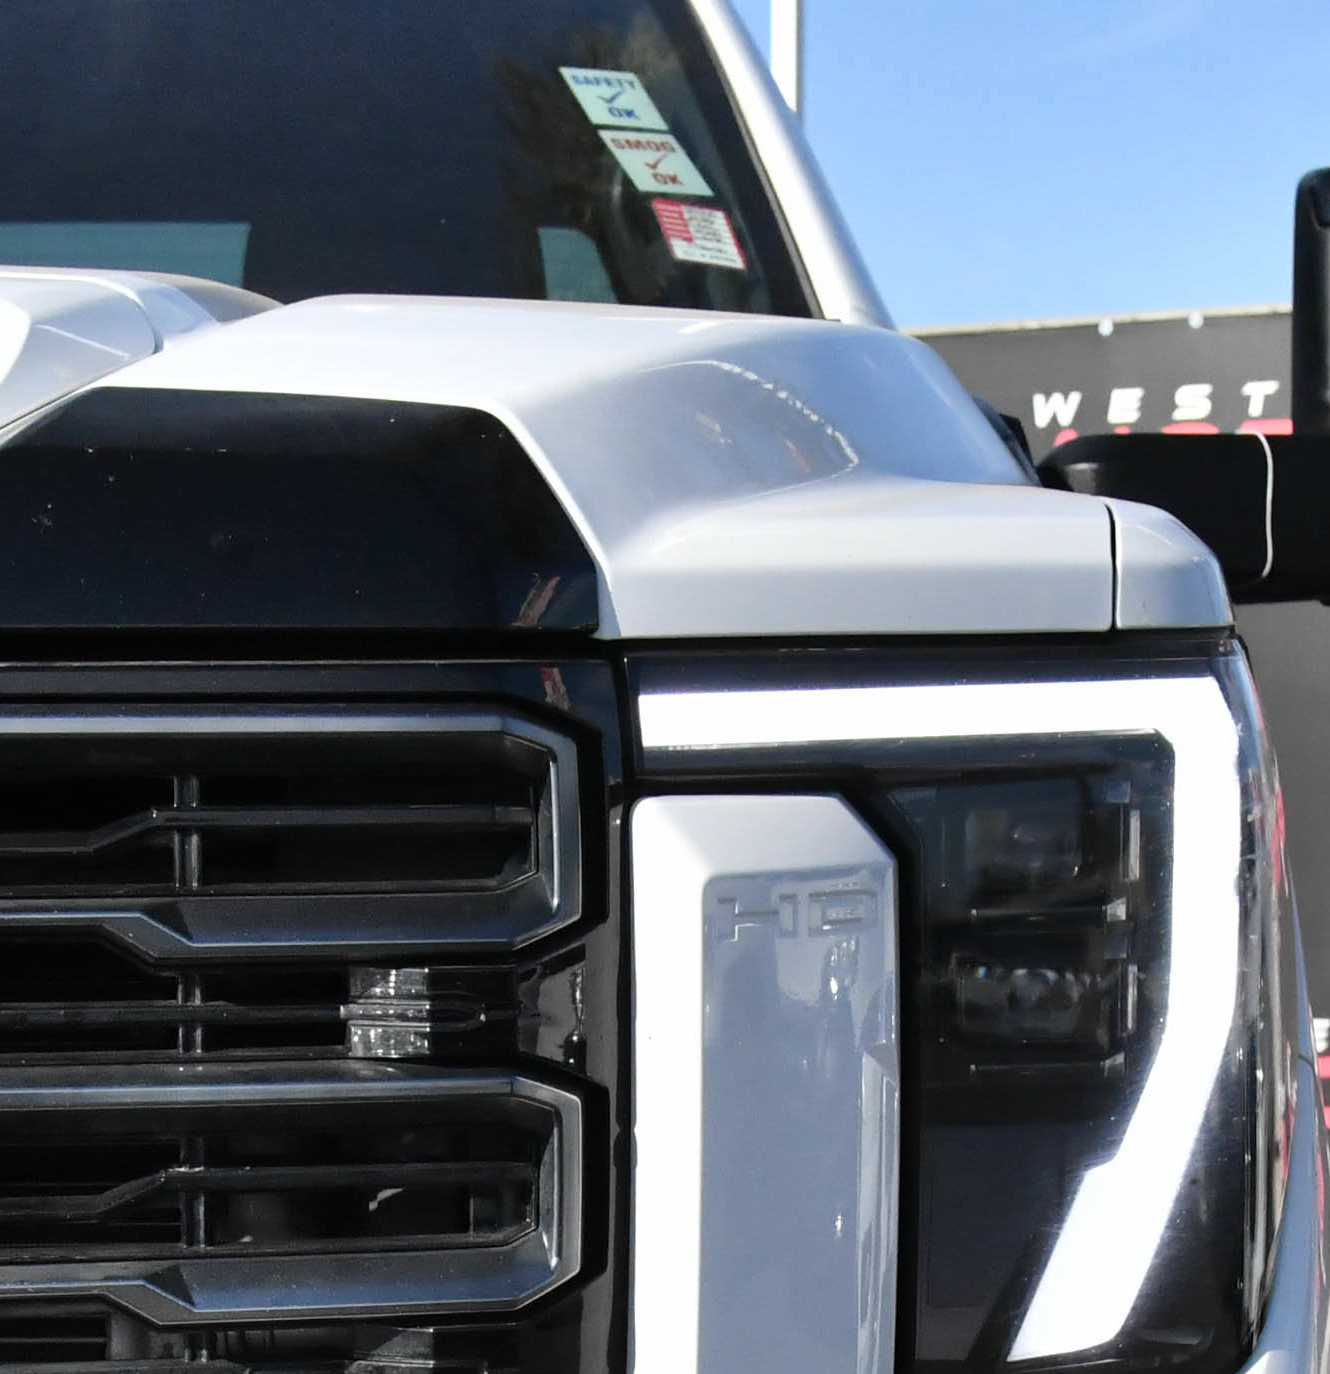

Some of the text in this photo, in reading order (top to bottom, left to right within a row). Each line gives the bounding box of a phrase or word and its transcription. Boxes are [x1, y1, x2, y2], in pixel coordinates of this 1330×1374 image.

[571, 74, 636, 89] SAFETY
[608, 107, 640, 120] OK
[611, 137, 677, 153] SMOG
[652, 172, 684, 186] OK
